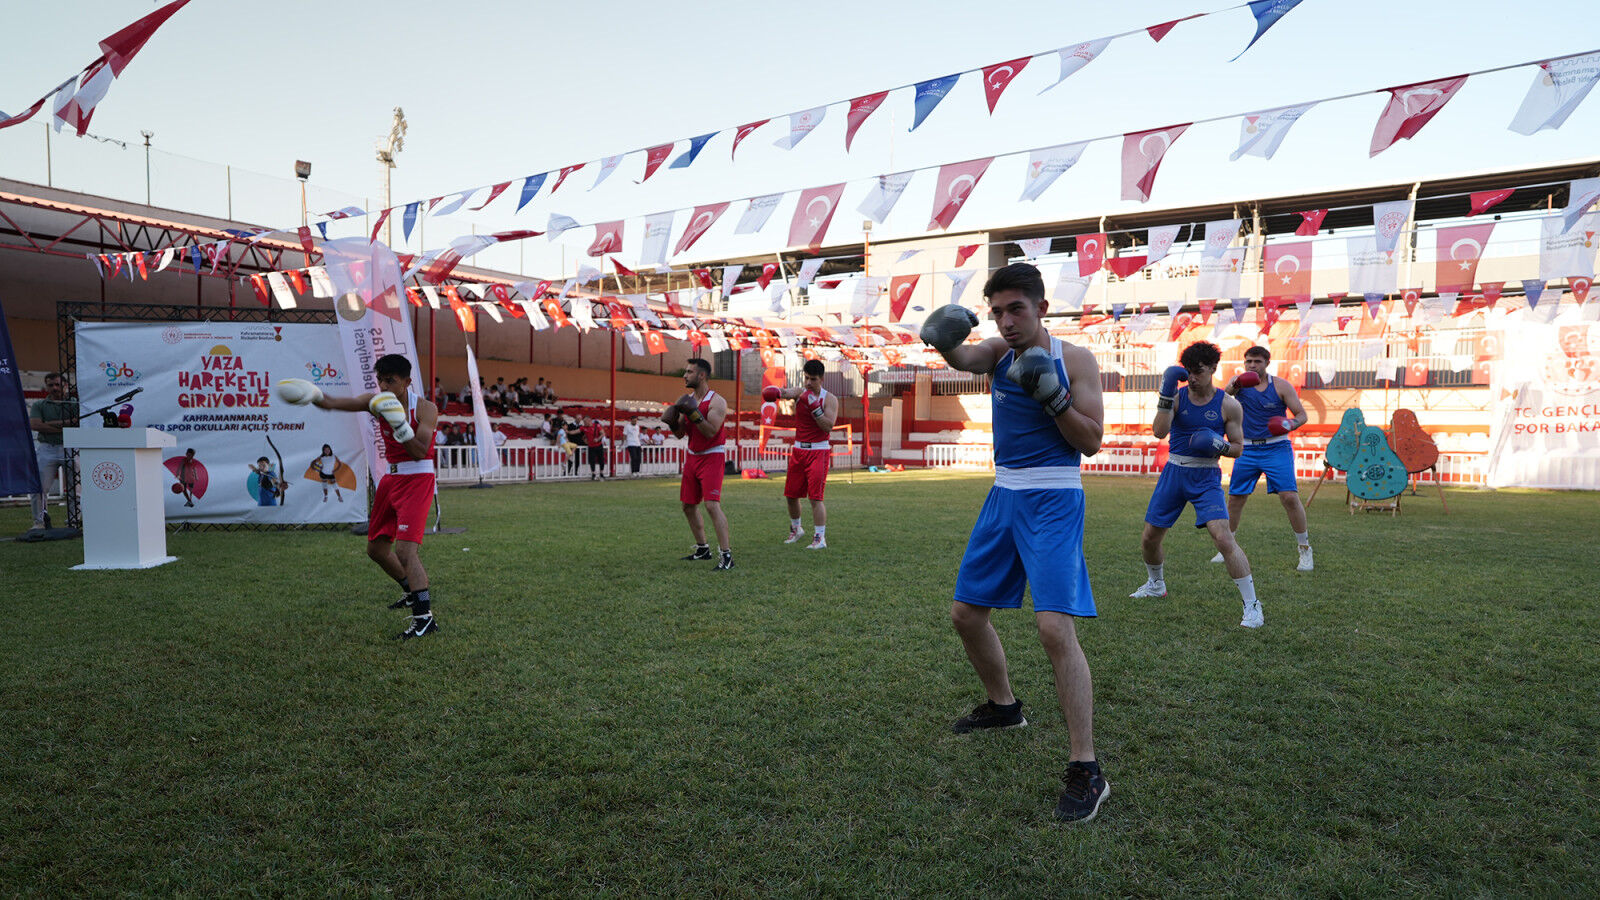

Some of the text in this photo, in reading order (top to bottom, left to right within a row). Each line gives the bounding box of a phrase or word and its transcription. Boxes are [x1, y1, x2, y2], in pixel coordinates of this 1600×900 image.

[201, 355, 243, 370] YAZA
[179, 371, 269, 394] HAREKETLİ
[178, 393, 270, 408] GİRİYORUZ
[183, 414, 268, 423] KAHRAMANMARAŞ
[194, 423, 240, 431] OKULLARI
[241, 423, 269, 433] AÇILIŞ
[272, 422, 304, 431] TÖRENİ
